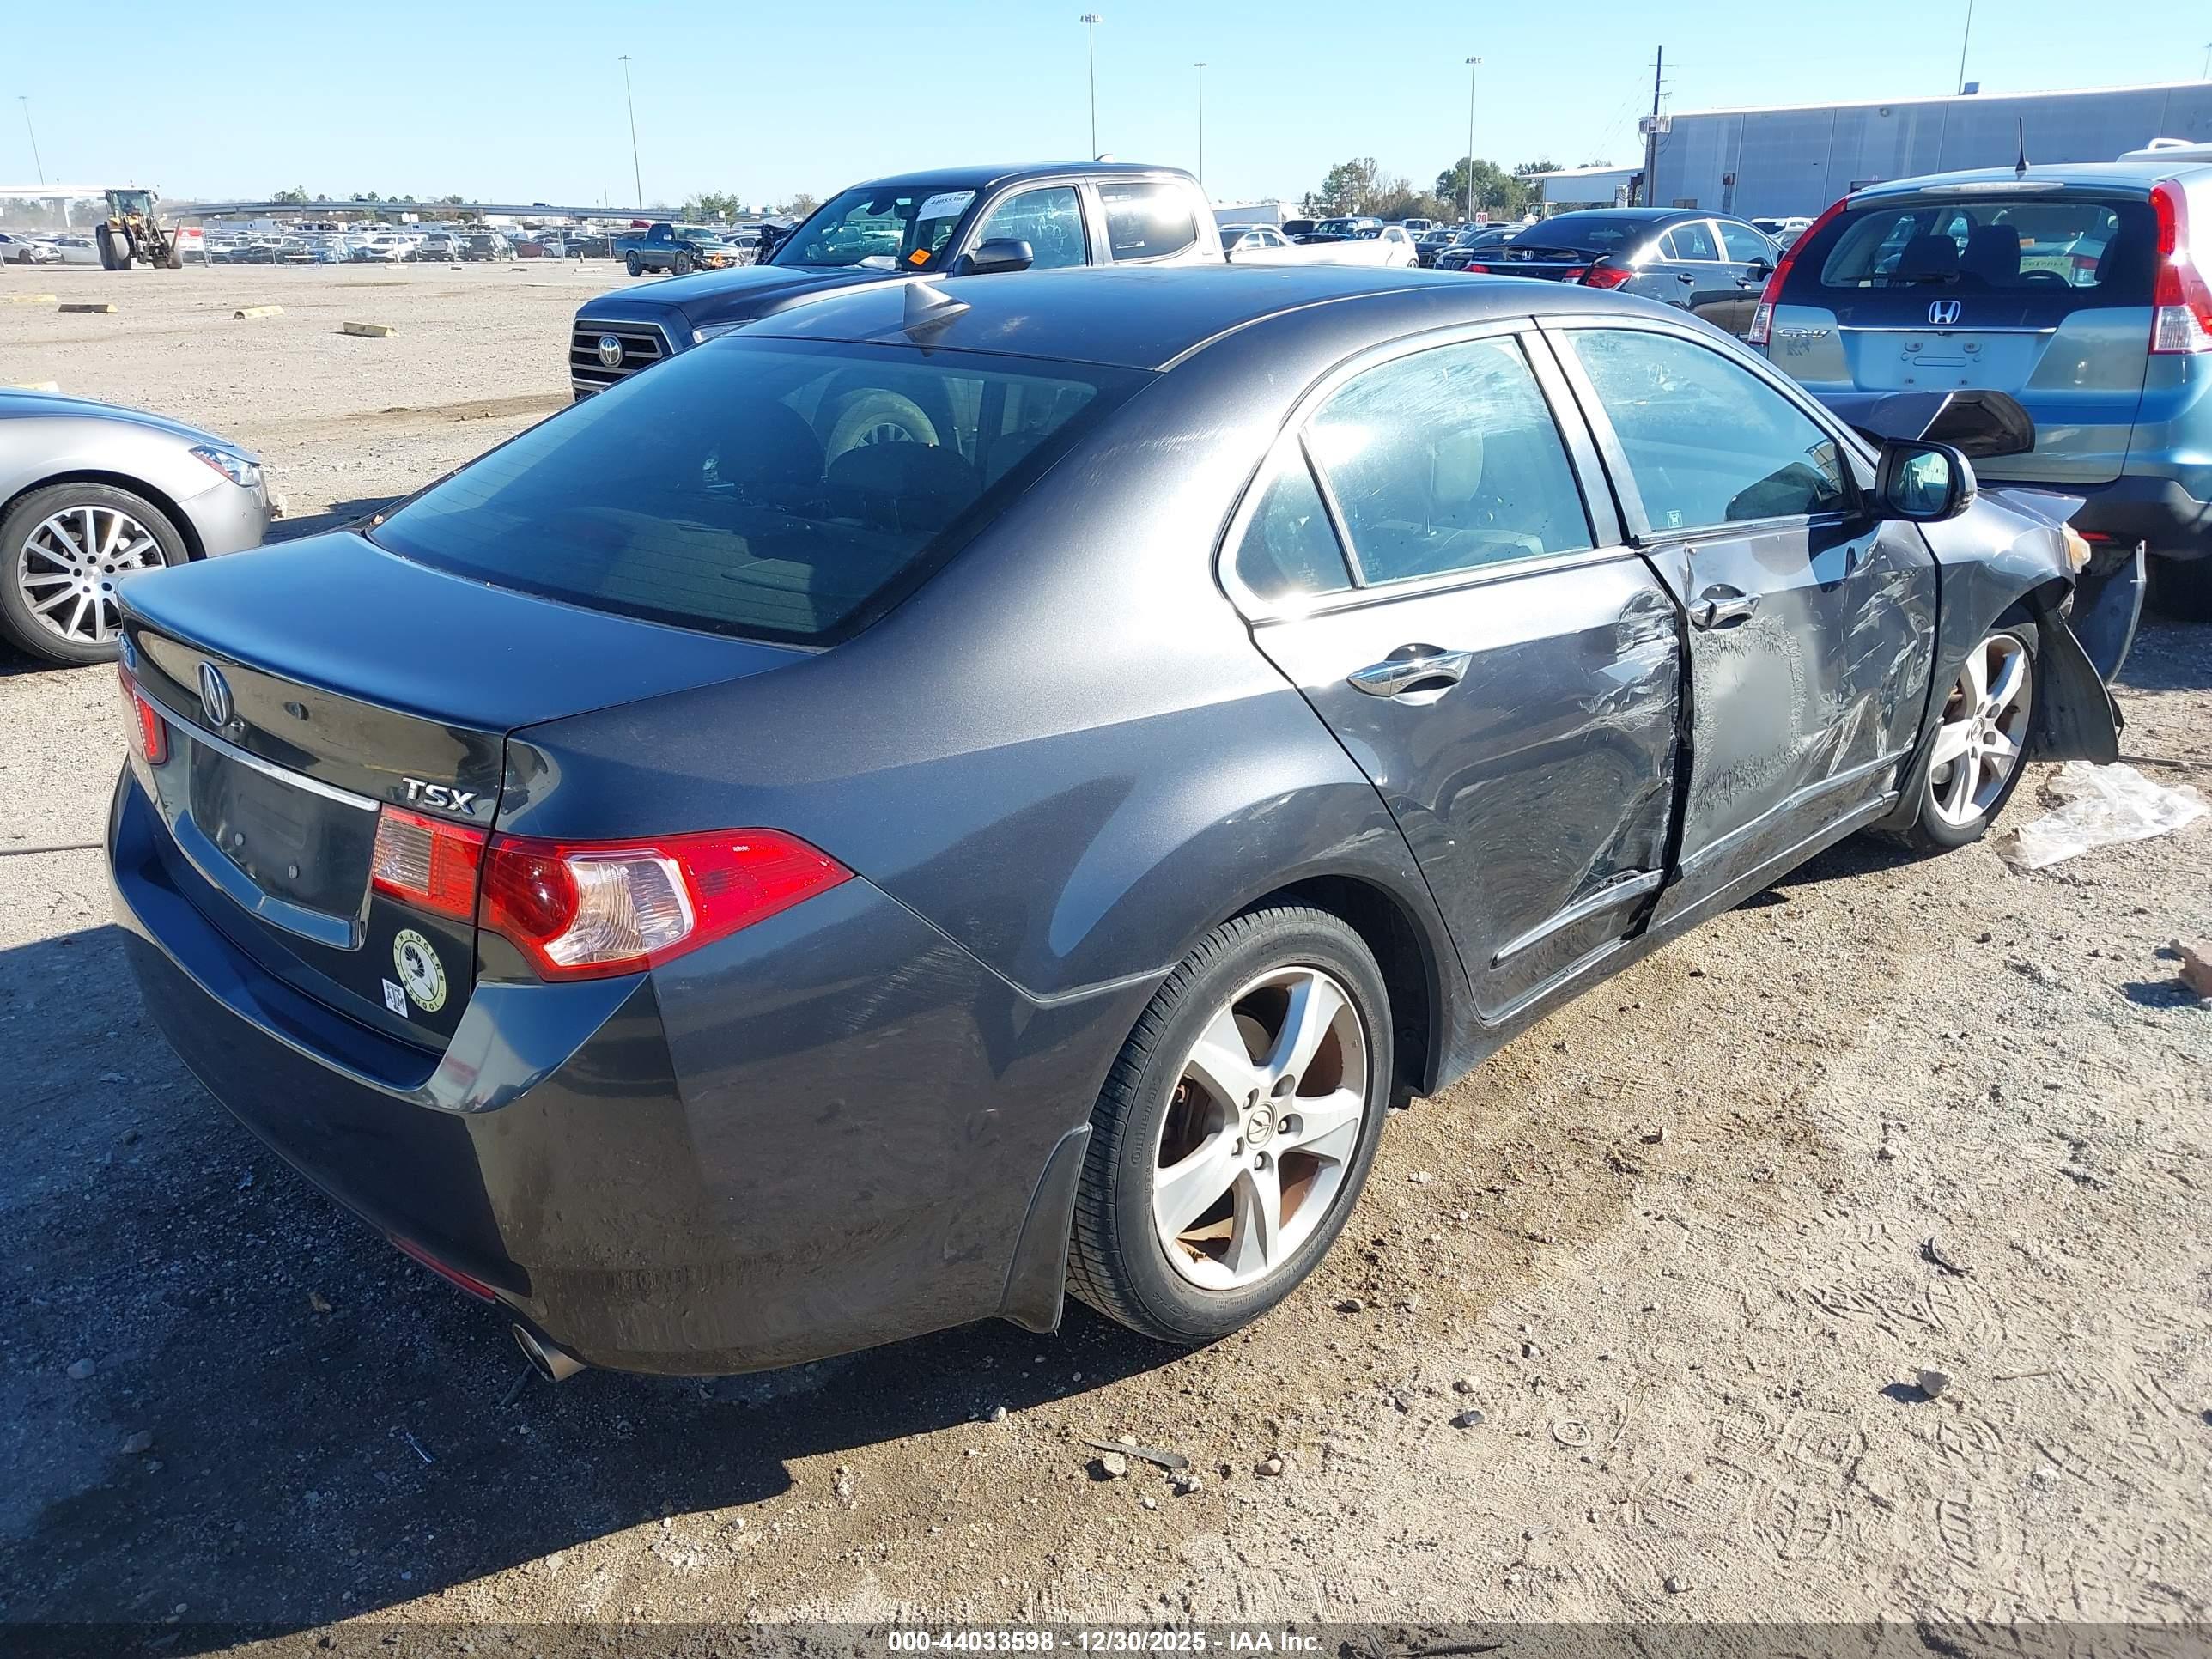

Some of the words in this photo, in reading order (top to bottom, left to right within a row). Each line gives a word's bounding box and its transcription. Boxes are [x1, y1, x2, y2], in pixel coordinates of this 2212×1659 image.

[1477, 214, 1486, 223] 20
[402, 777, 478, 815] TSX
[402, 980, 441, 1011] SCHOOL
